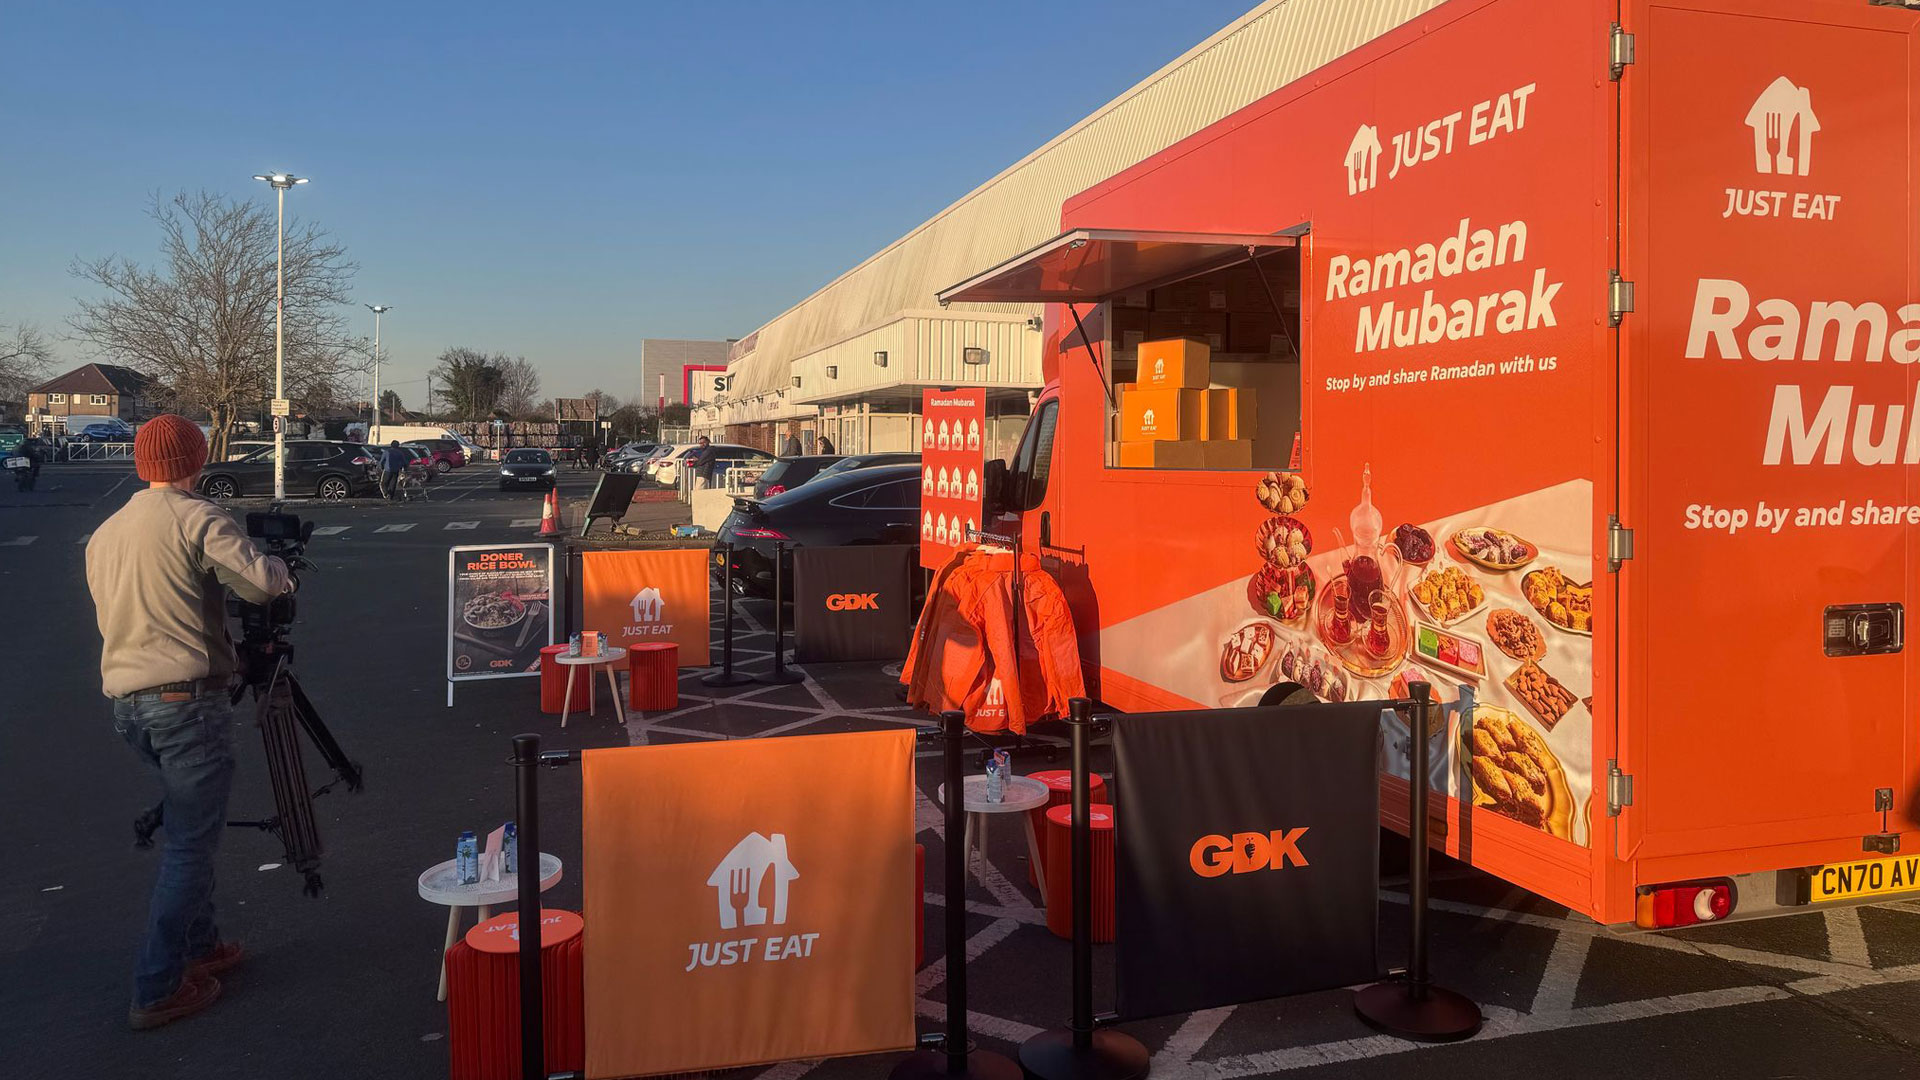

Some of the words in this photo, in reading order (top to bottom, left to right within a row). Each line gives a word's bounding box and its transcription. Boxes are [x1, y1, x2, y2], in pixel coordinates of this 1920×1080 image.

[1388, 111, 1463, 180] JUST
[1469, 82, 1536, 146] EAT
[1722, 188, 1787, 219] JUST
[1792, 193, 1841, 221] EAT
[1325, 217, 1527, 302] Ramadan
[1354, 267, 1564, 353] Mubarak
[1325, 377, 1350, 392] Stop
[1352, 373, 1367, 391] by
[1368, 370, 1391, 387] and
[1392, 368, 1427, 385] share
[1430, 360, 1495, 381] Ramadan
[1499, 354, 1534, 374] with
[1538, 356, 1557, 372] us
[930, 398, 953, 407] Ramadan
[953, 398, 975, 407] Mubarak
[1684, 503, 1748, 534] Stop
[1755, 502, 1789, 534] by
[1795, 500, 1846, 527] and
[1850, 499, 1920, 525] share
[467, 561, 496, 570] RICE
[499, 560, 536, 569] BOWL
[480, 552, 523, 561] DONER
[826, 593, 879, 611] GDK
[622, 625, 650, 637] JUST
[651, 624, 673, 634] EAT
[489, 660, 512, 668] GDK
[975, 709, 997, 717] JUST
[1189, 826, 1310, 878] GDK
[1822, 863, 1883, 895] CN70
[1890, 858, 1919, 888] AV
[685, 938, 758, 972] JUST
[764, 932, 820, 961] EAT
